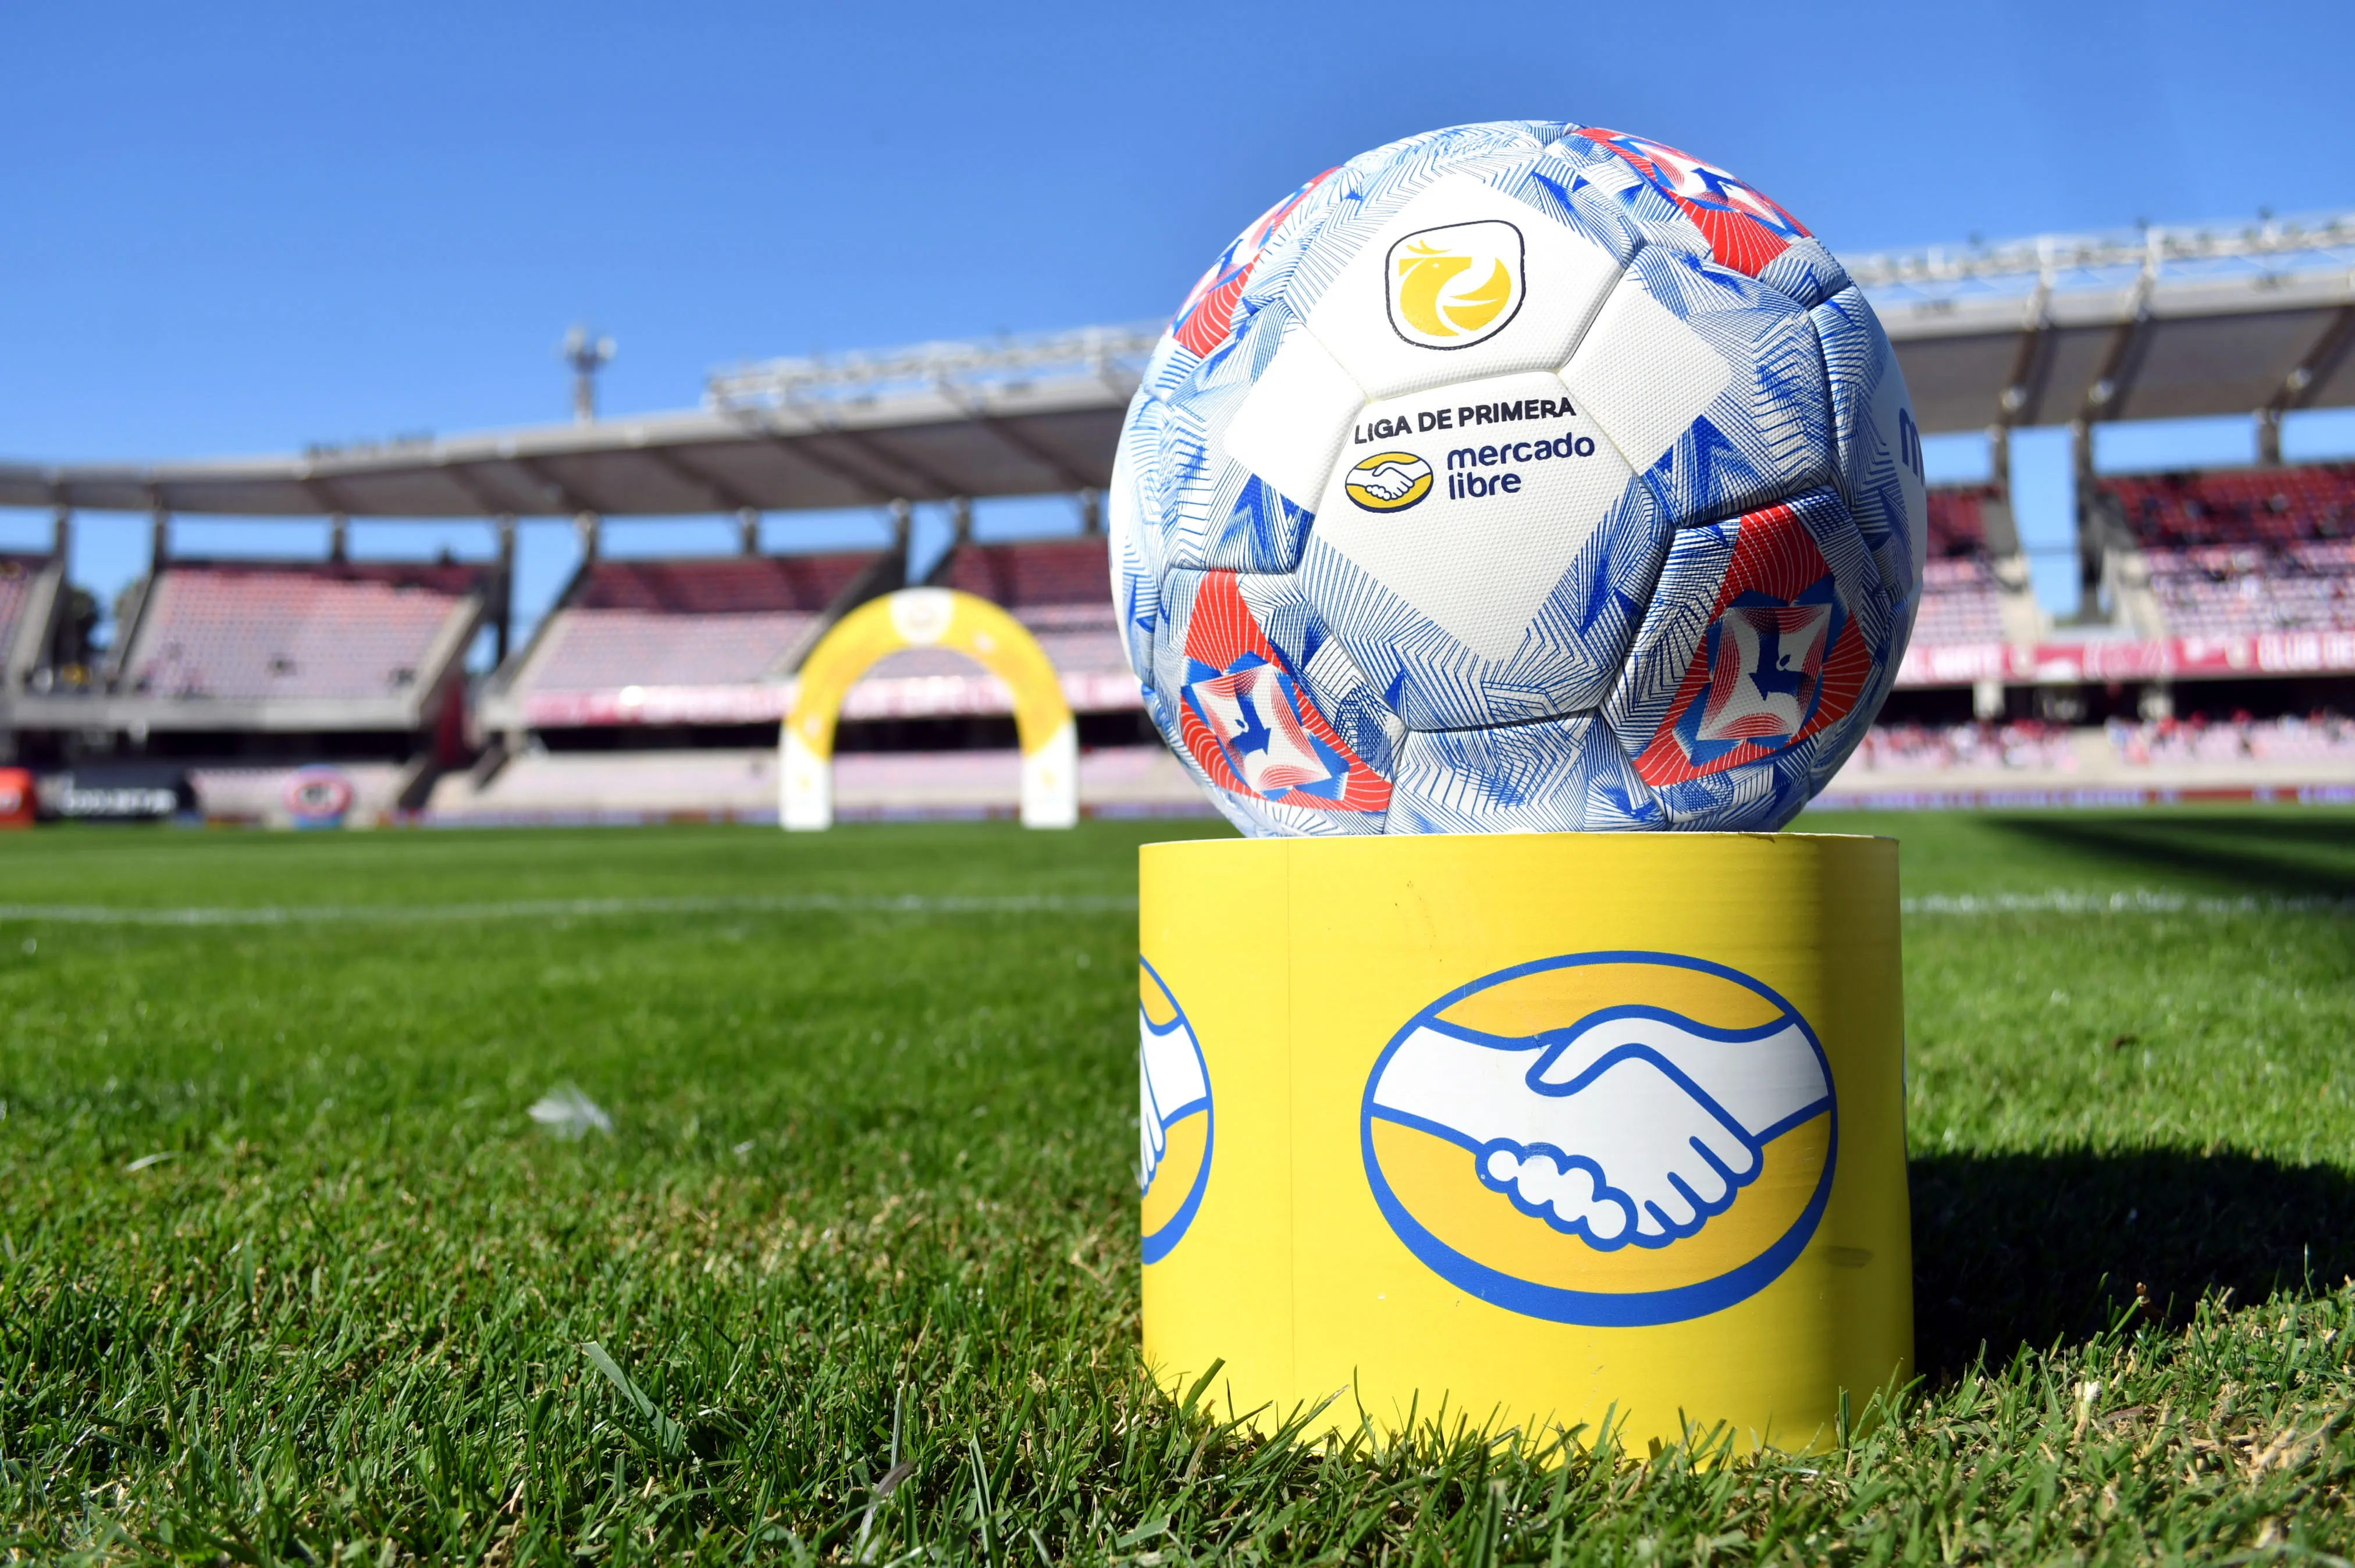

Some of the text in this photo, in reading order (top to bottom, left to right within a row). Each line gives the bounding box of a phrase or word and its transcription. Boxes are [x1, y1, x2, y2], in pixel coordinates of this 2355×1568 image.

[1354, 397, 1577, 444] LIGA DE PRIMERA
[1447, 432, 1595, 471] mercado
[1448, 472, 1522, 500] libre
